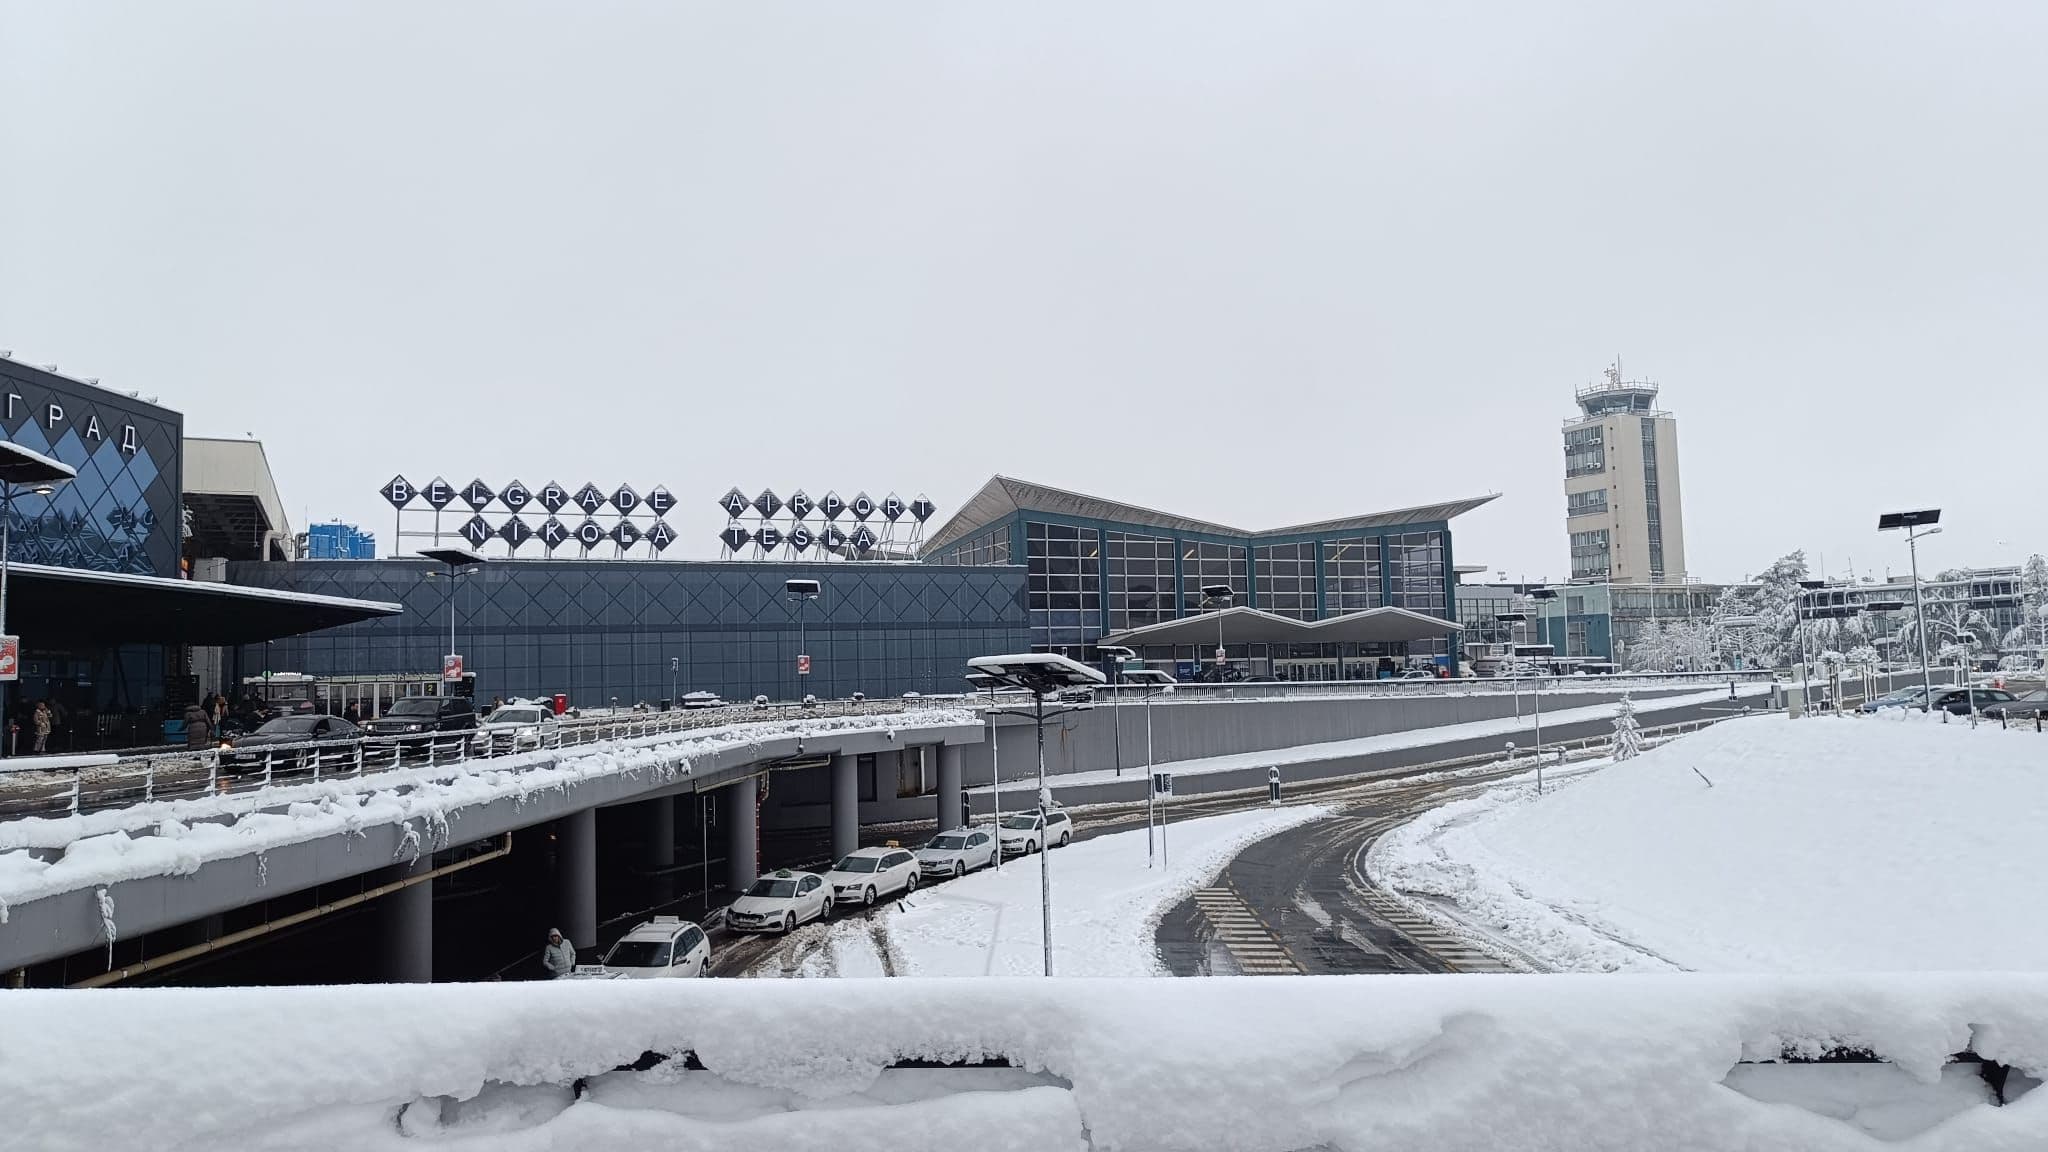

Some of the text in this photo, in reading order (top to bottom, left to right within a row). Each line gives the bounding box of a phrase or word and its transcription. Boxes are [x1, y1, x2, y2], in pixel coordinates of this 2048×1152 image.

[9, 393, 136, 455] ГРАД
[392, 482, 929, 517] BELGRADE AIRPORT
[470, 522, 871, 547] NIKOLA TESLA
